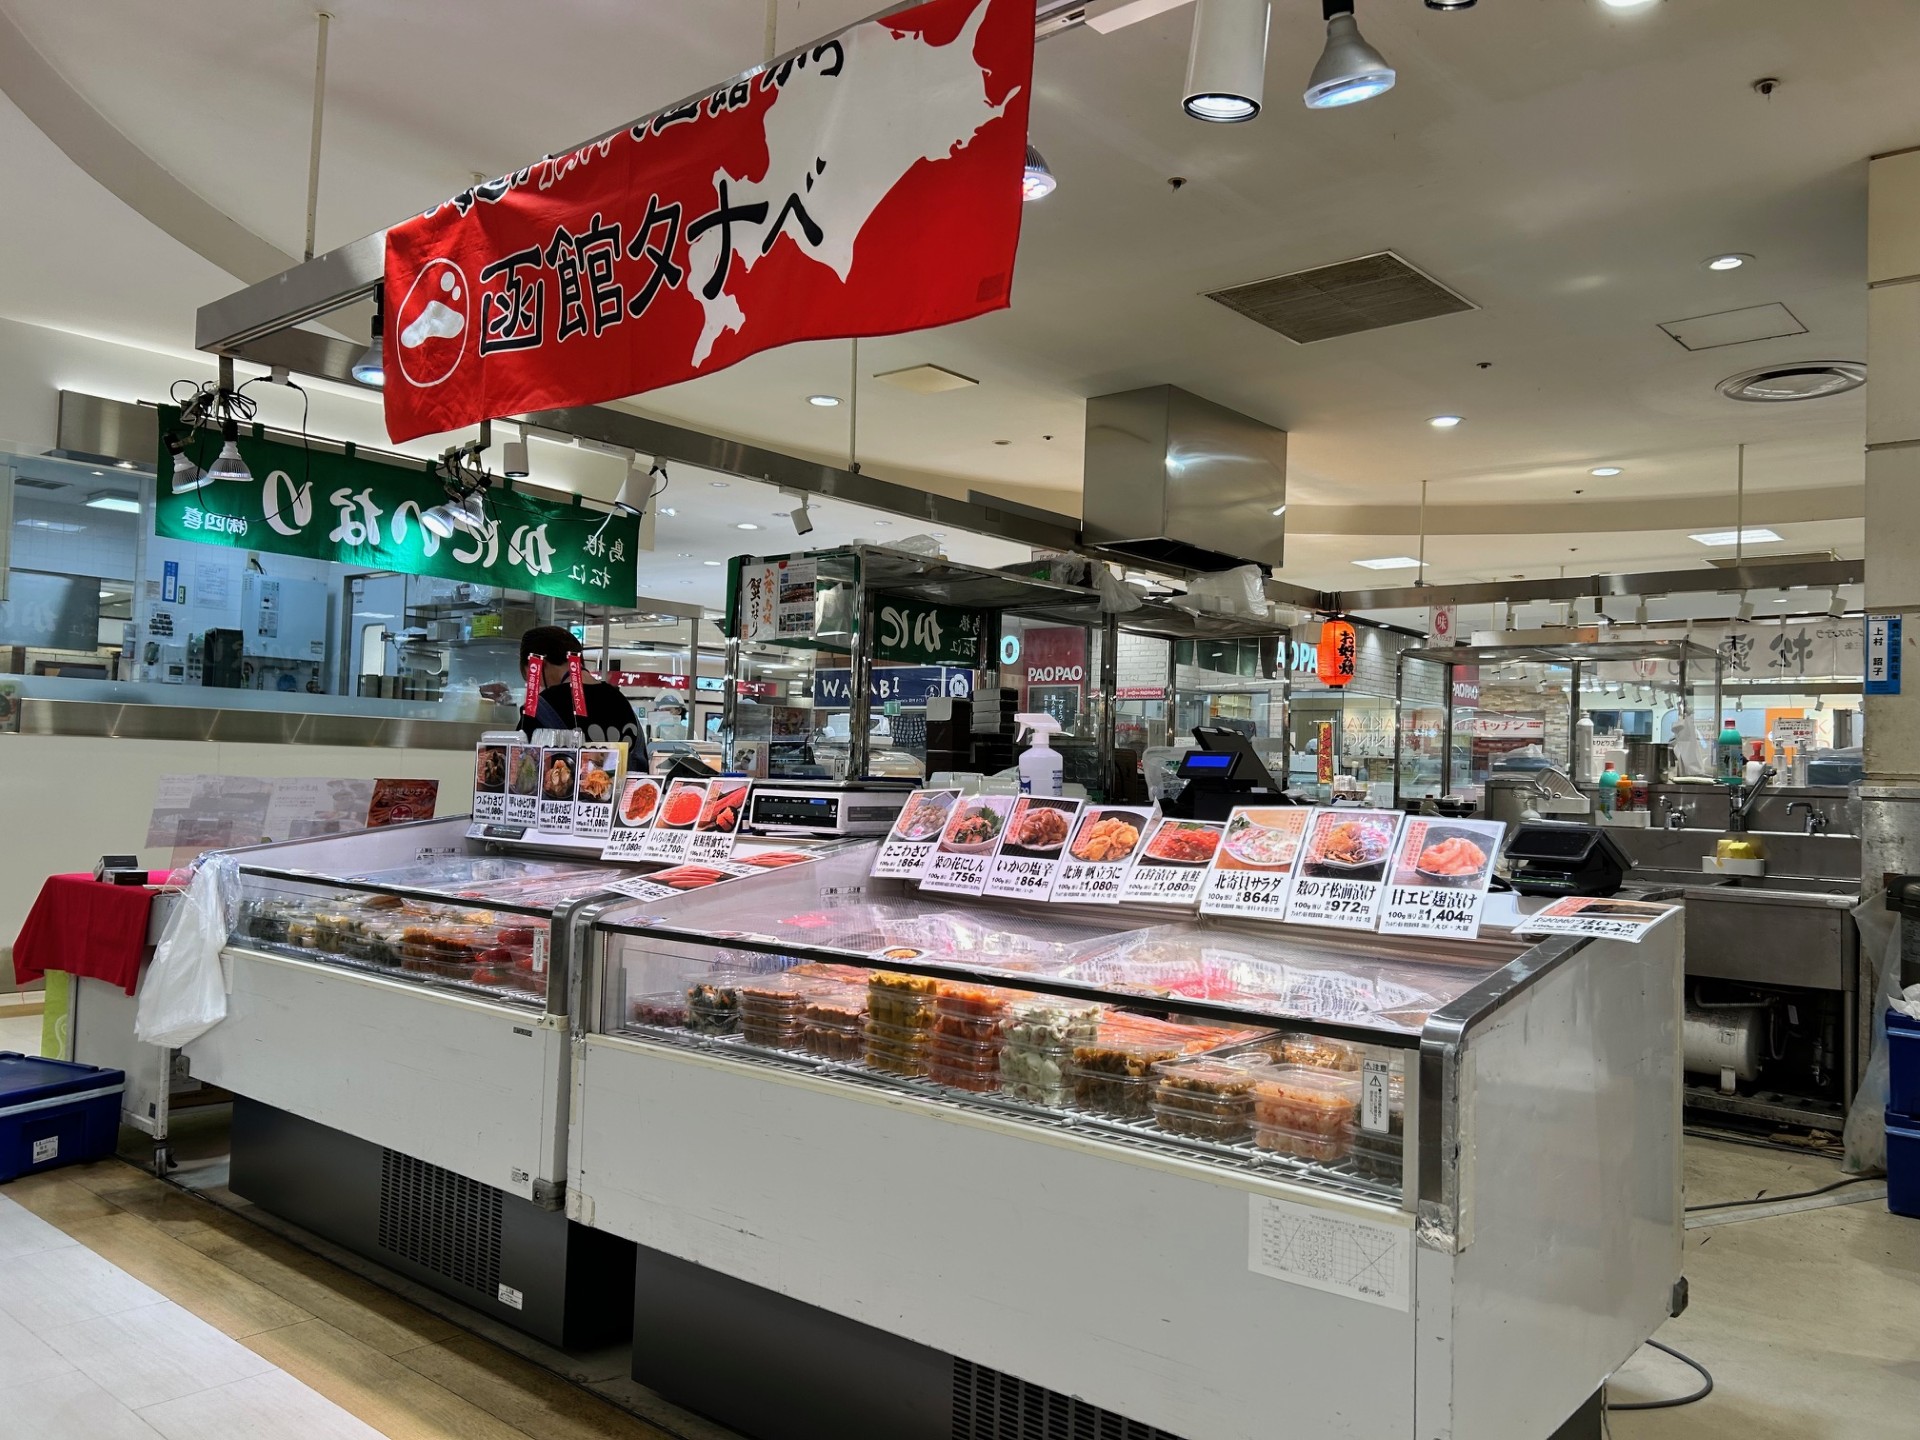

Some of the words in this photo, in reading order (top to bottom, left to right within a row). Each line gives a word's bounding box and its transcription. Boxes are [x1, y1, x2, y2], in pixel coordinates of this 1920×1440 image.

[477, 157, 824, 356] 函館タナベ
[1873, 627, 1883, 646] 上村
[1028, 665, 1083, 682] PAOPAO
[822, 676, 899, 699] WABI
[611, 830, 646, 842] 紅鮭キムチ
[883, 845, 932, 858] たこわさび
[933, 855, 985, 873] 菜の花にしん
[996, 860, 1055, 877] いかの塩辛
[1135, 868, 1177, 882] 石狩漬け
[1215, 874, 1284, 892] 北寄貝サラダ
[1296, 880, 1377, 901] 数の子松前漬け
[1391, 888, 1478, 910] 甘エビ麹漬け
[1372, 1063, 1387, 1073] 注意
